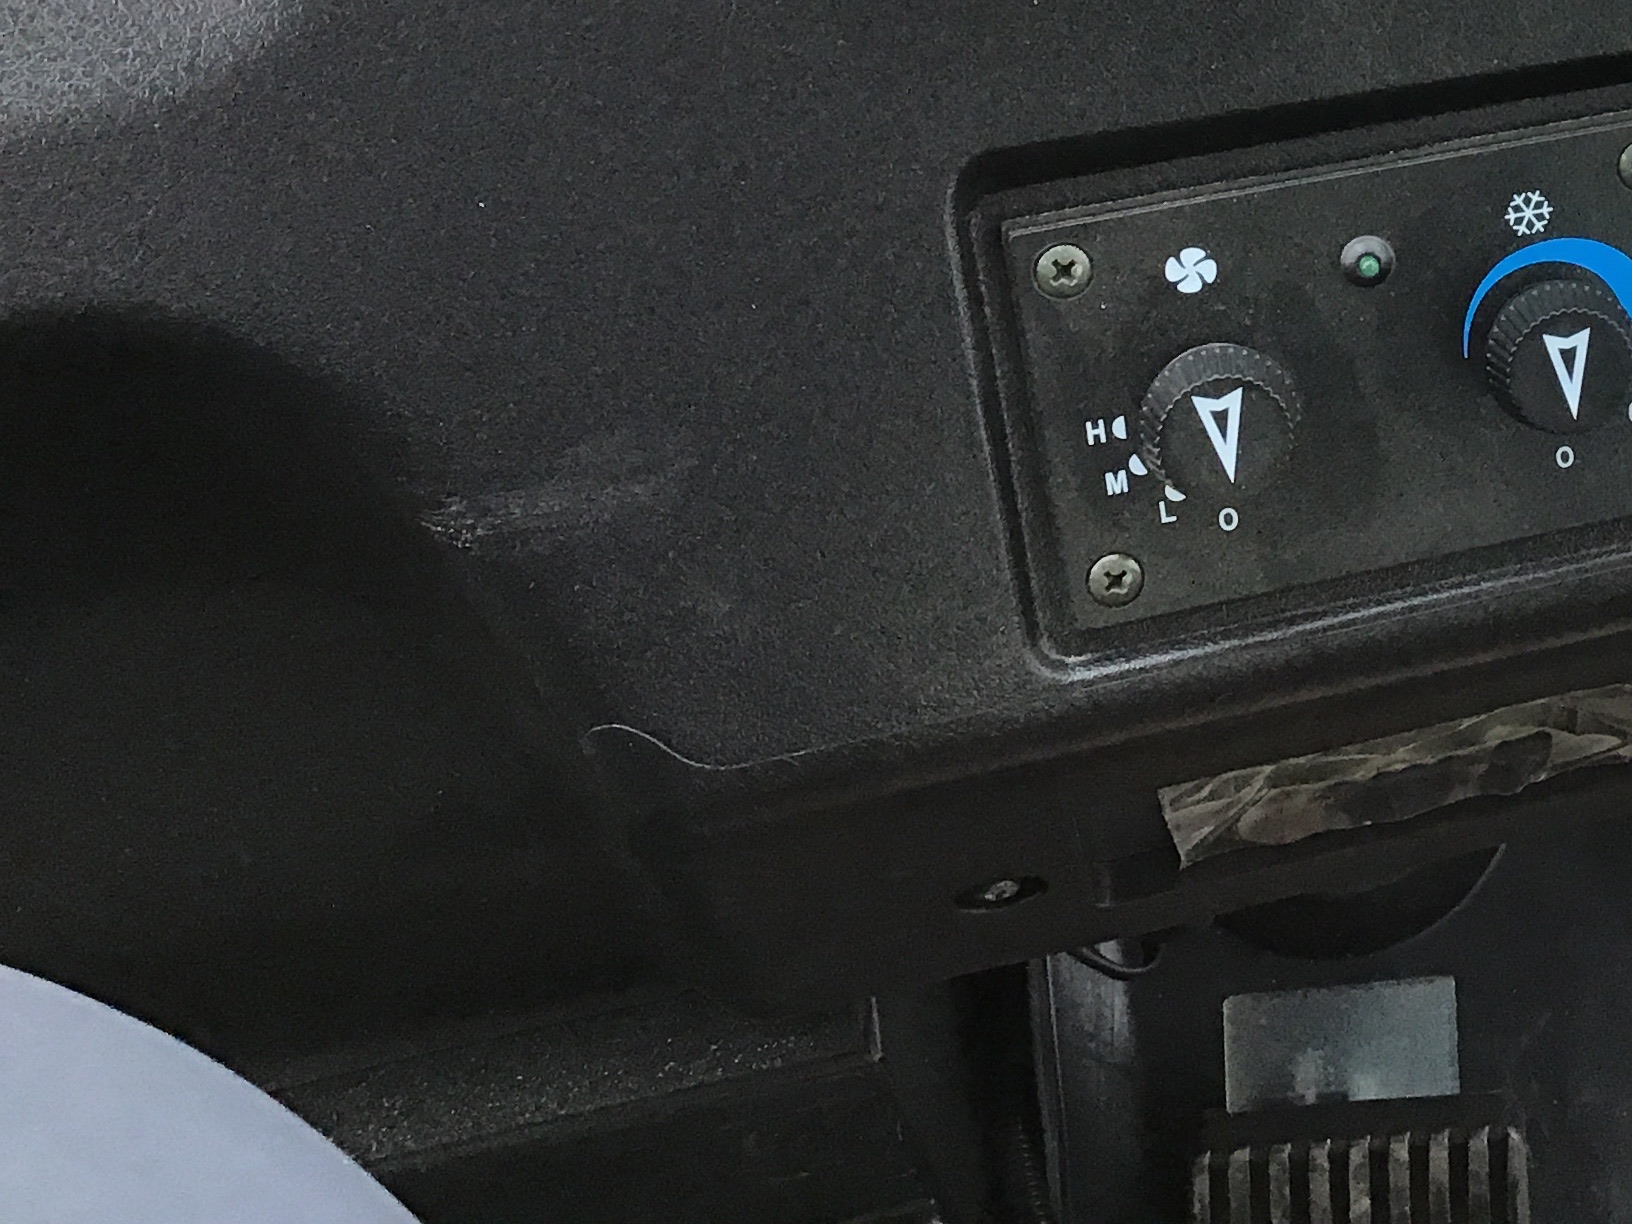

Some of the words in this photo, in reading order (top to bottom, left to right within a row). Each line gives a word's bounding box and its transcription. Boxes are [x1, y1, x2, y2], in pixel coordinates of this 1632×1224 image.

[1085, 419, 1107, 446] H
[1104, 469, 1129, 496] M
[1158, 501, 1177, 524] L
